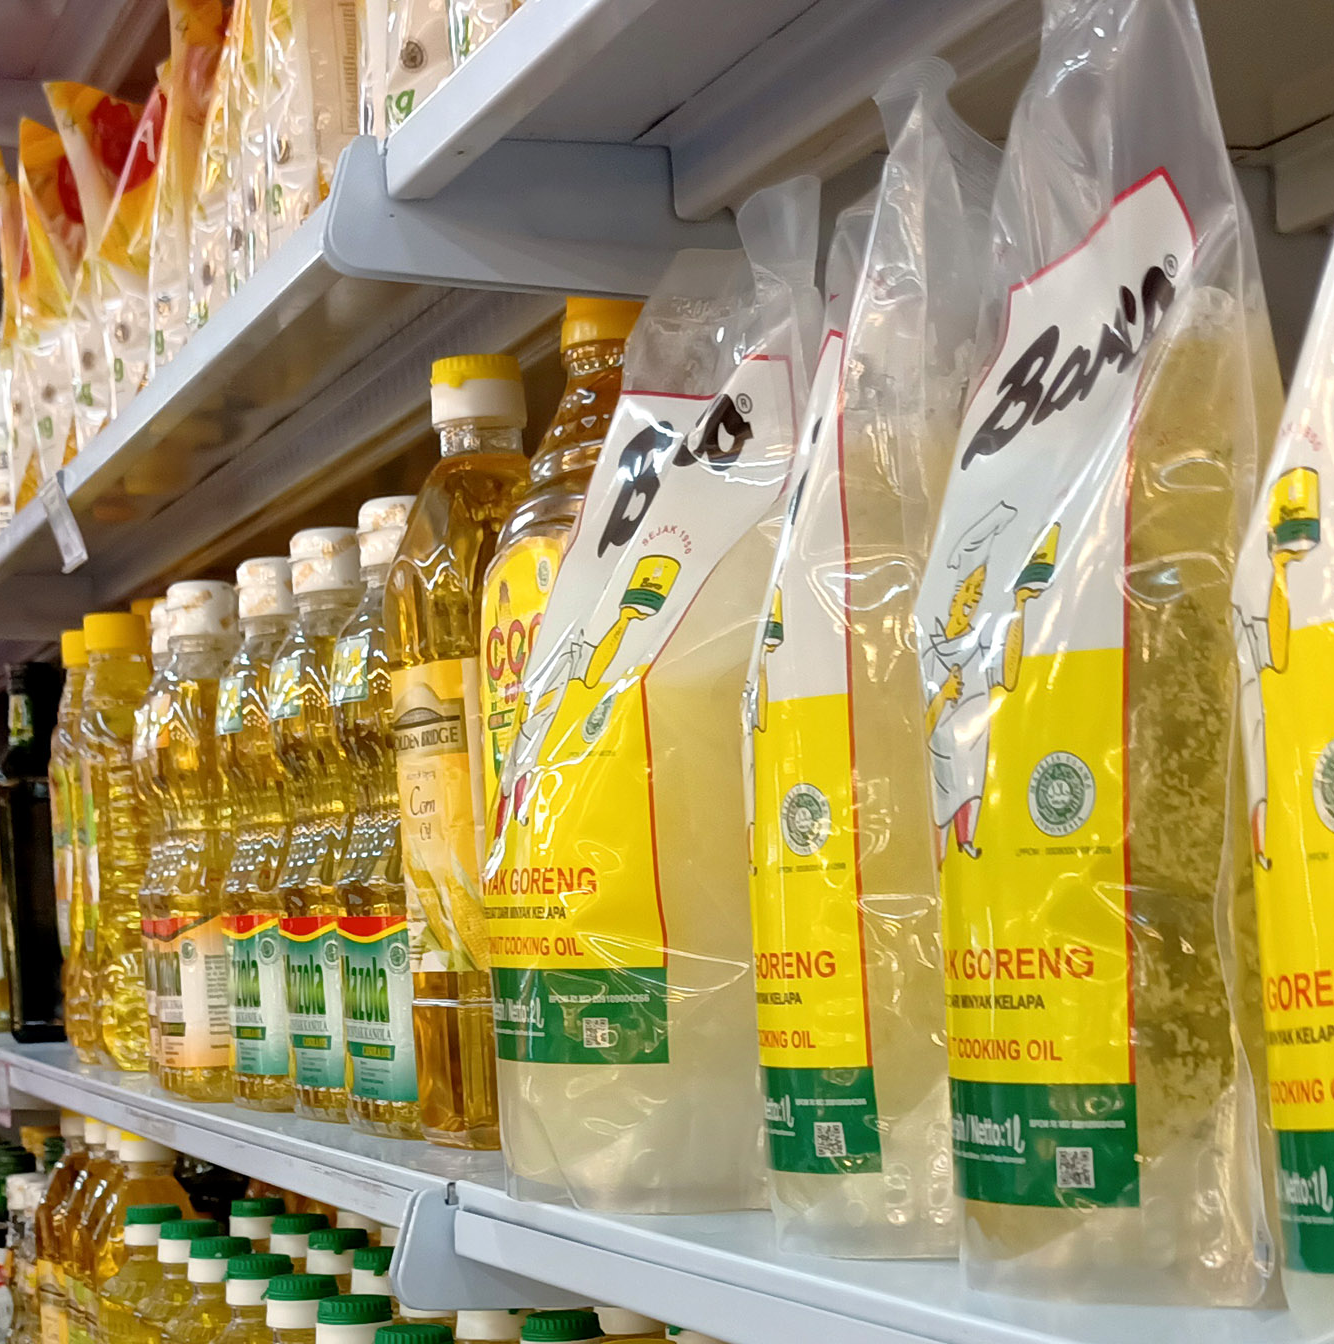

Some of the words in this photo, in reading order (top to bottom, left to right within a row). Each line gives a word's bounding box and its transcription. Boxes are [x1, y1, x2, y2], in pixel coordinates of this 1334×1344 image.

[421, 726, 460, 747] BRIDGE
[409, 786, 437, 817] Corn
[510, 867, 597, 896] GORENG
[504, 936, 550, 957] COOKING
[554, 936, 585, 957] OIL
[962, 945, 1095, 981] GORENG
[994, 994, 1046, 1010] KELAPA
[791, 1030, 817, 1049] OIL
[957, 1037, 1021, 1061] COOKING
[1026, 1040, 1063, 1062] OIL
